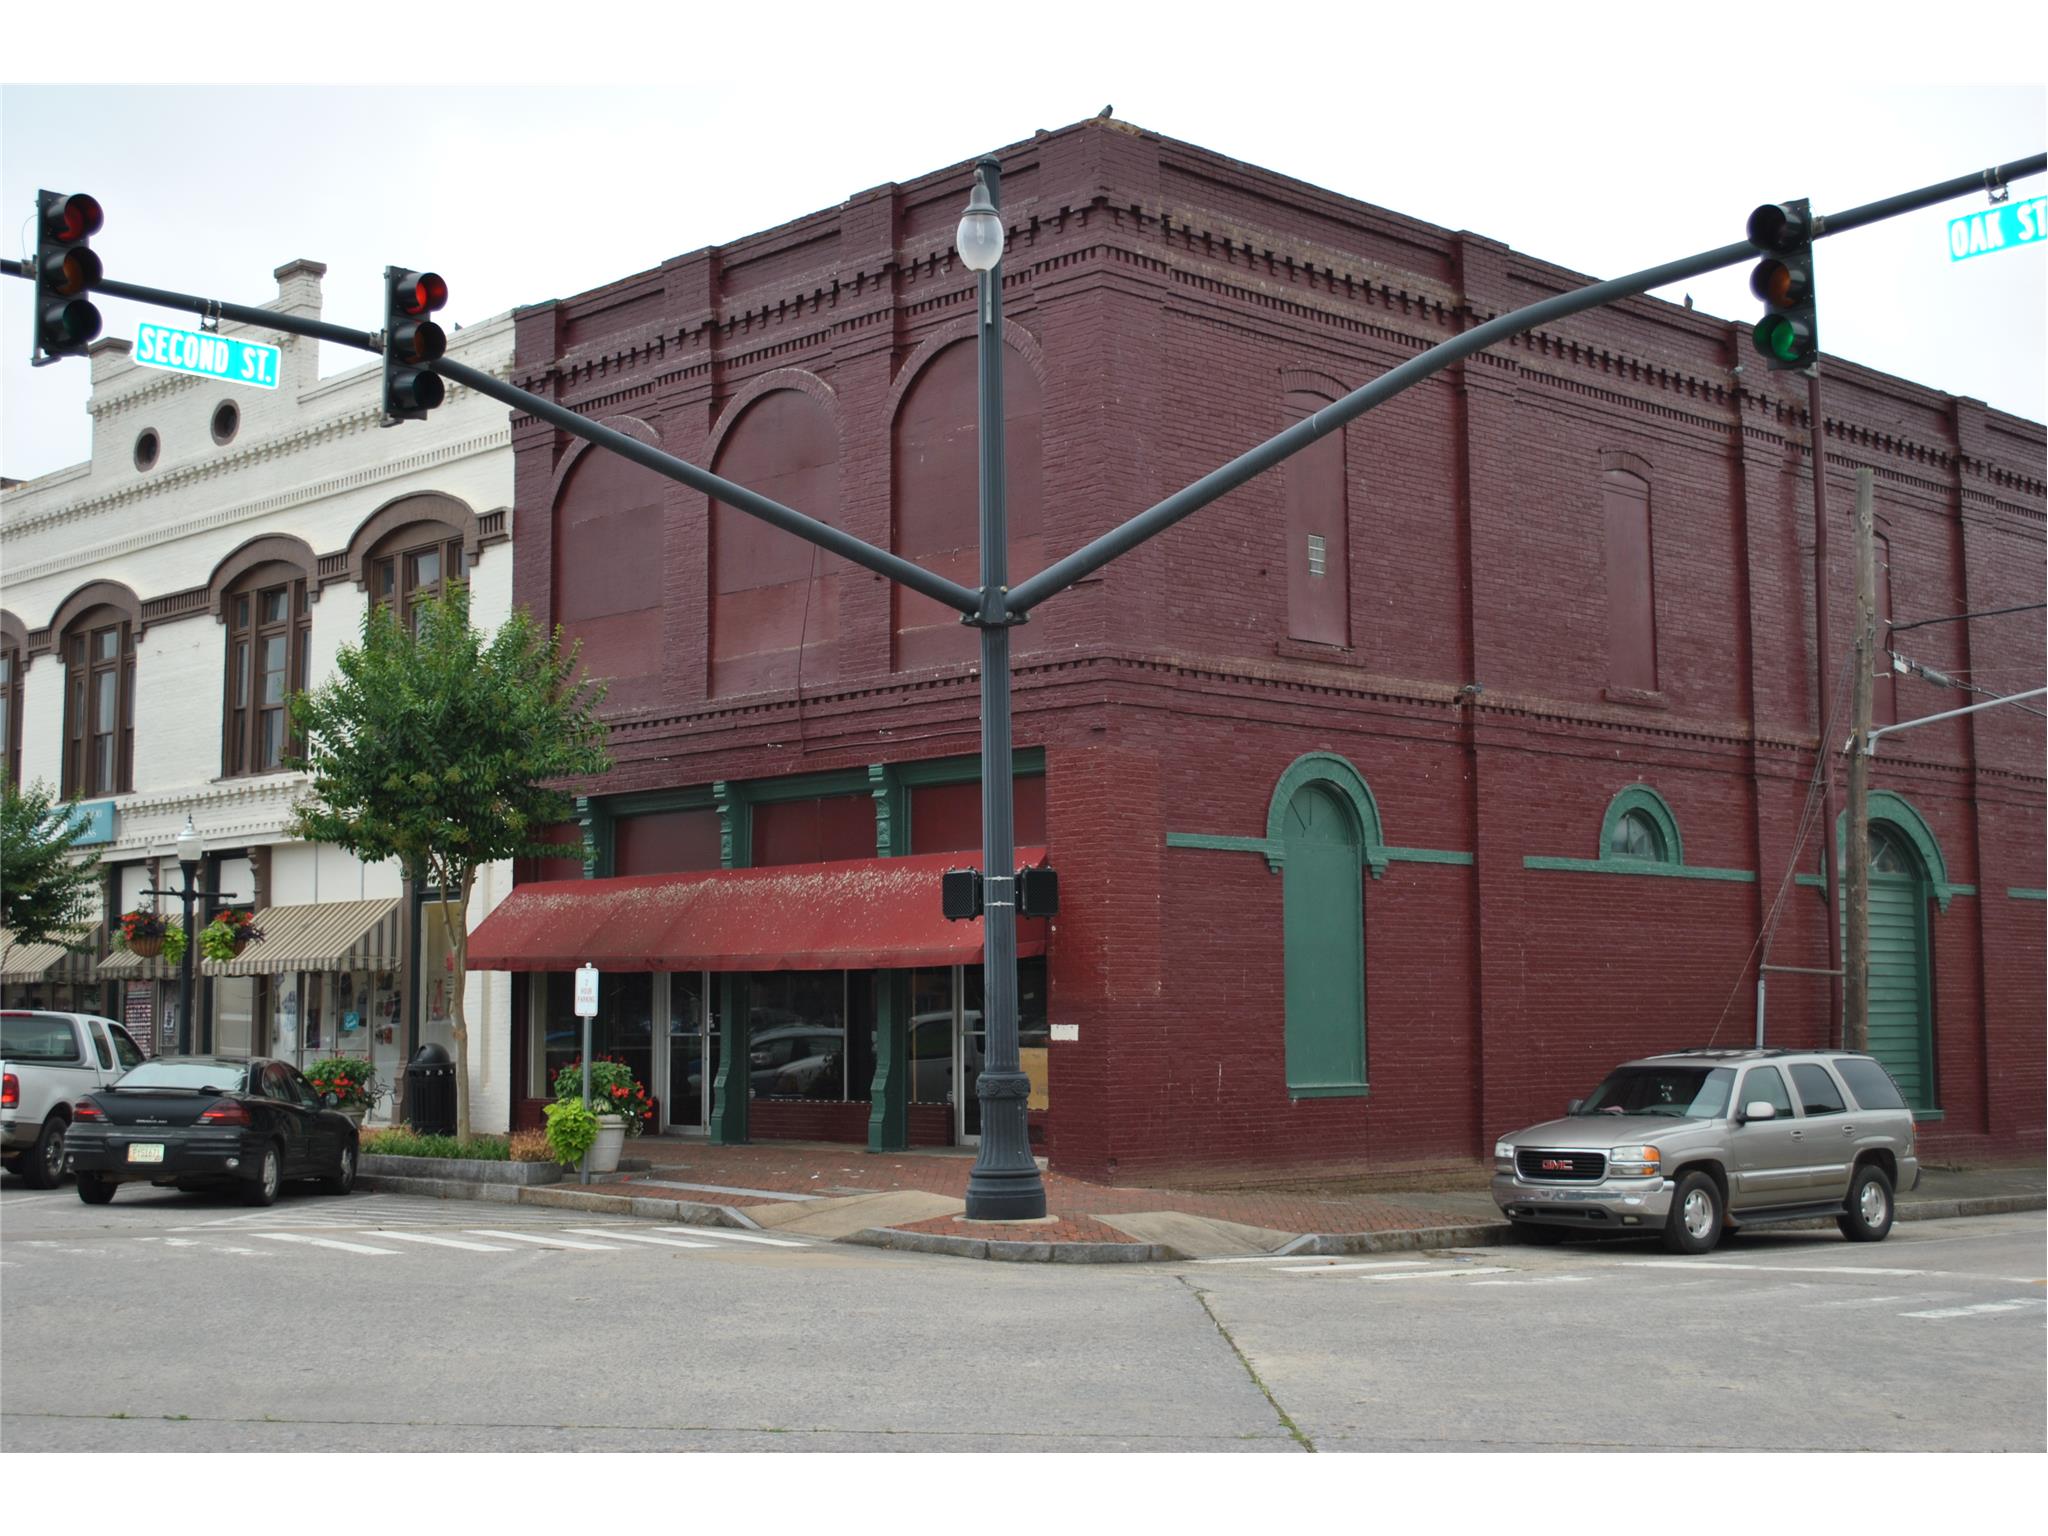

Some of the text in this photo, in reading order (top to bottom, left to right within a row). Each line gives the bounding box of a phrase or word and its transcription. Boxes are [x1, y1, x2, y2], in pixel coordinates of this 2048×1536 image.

[1950, 210, 2004, 257] OAK
[140, 327, 272, 383] SECOND ST.
[1542, 1159, 1573, 1171] GMC
